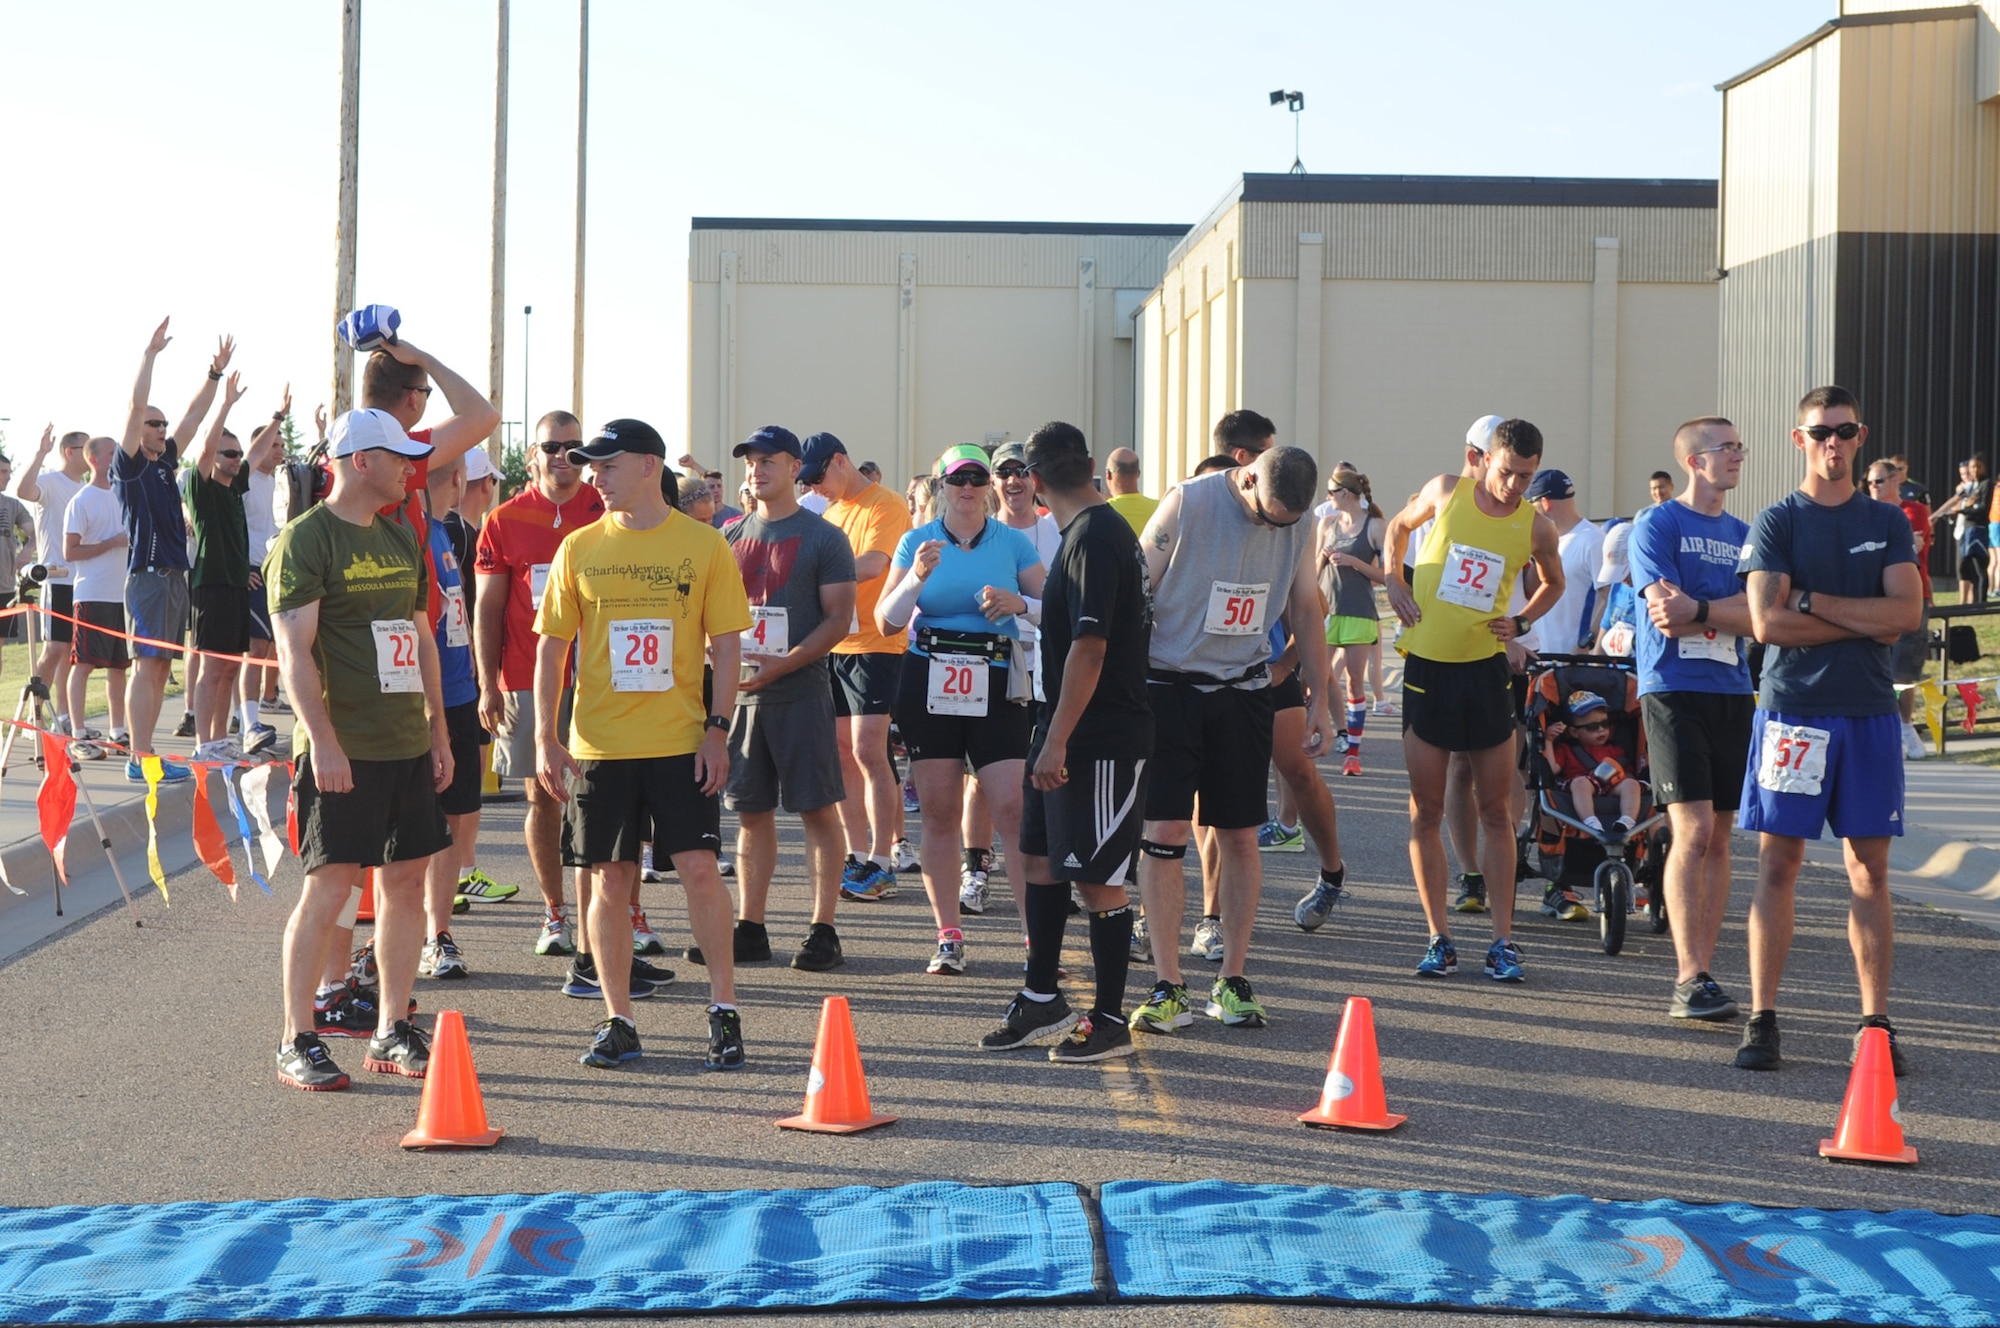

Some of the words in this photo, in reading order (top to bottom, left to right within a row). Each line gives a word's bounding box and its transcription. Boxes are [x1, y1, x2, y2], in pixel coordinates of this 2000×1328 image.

[1680, 536, 1706, 553] AIR
[1457, 558, 1488, 590] 52
[1700, 553, 1734, 566] ATHLETICS
[347, 582, 385, 593] MISSOULA
[385, 580, 417, 589] MARATH
[1223, 597, 1255, 626] 50
[753, 619, 766, 645] 4
[1609, 632, 1624, 654] 48
[389, 634, 416, 667] 22
[625, 634, 659, 666] 28
[943, 666, 972, 695] 20
[1775, 737, 1811, 770] 57
